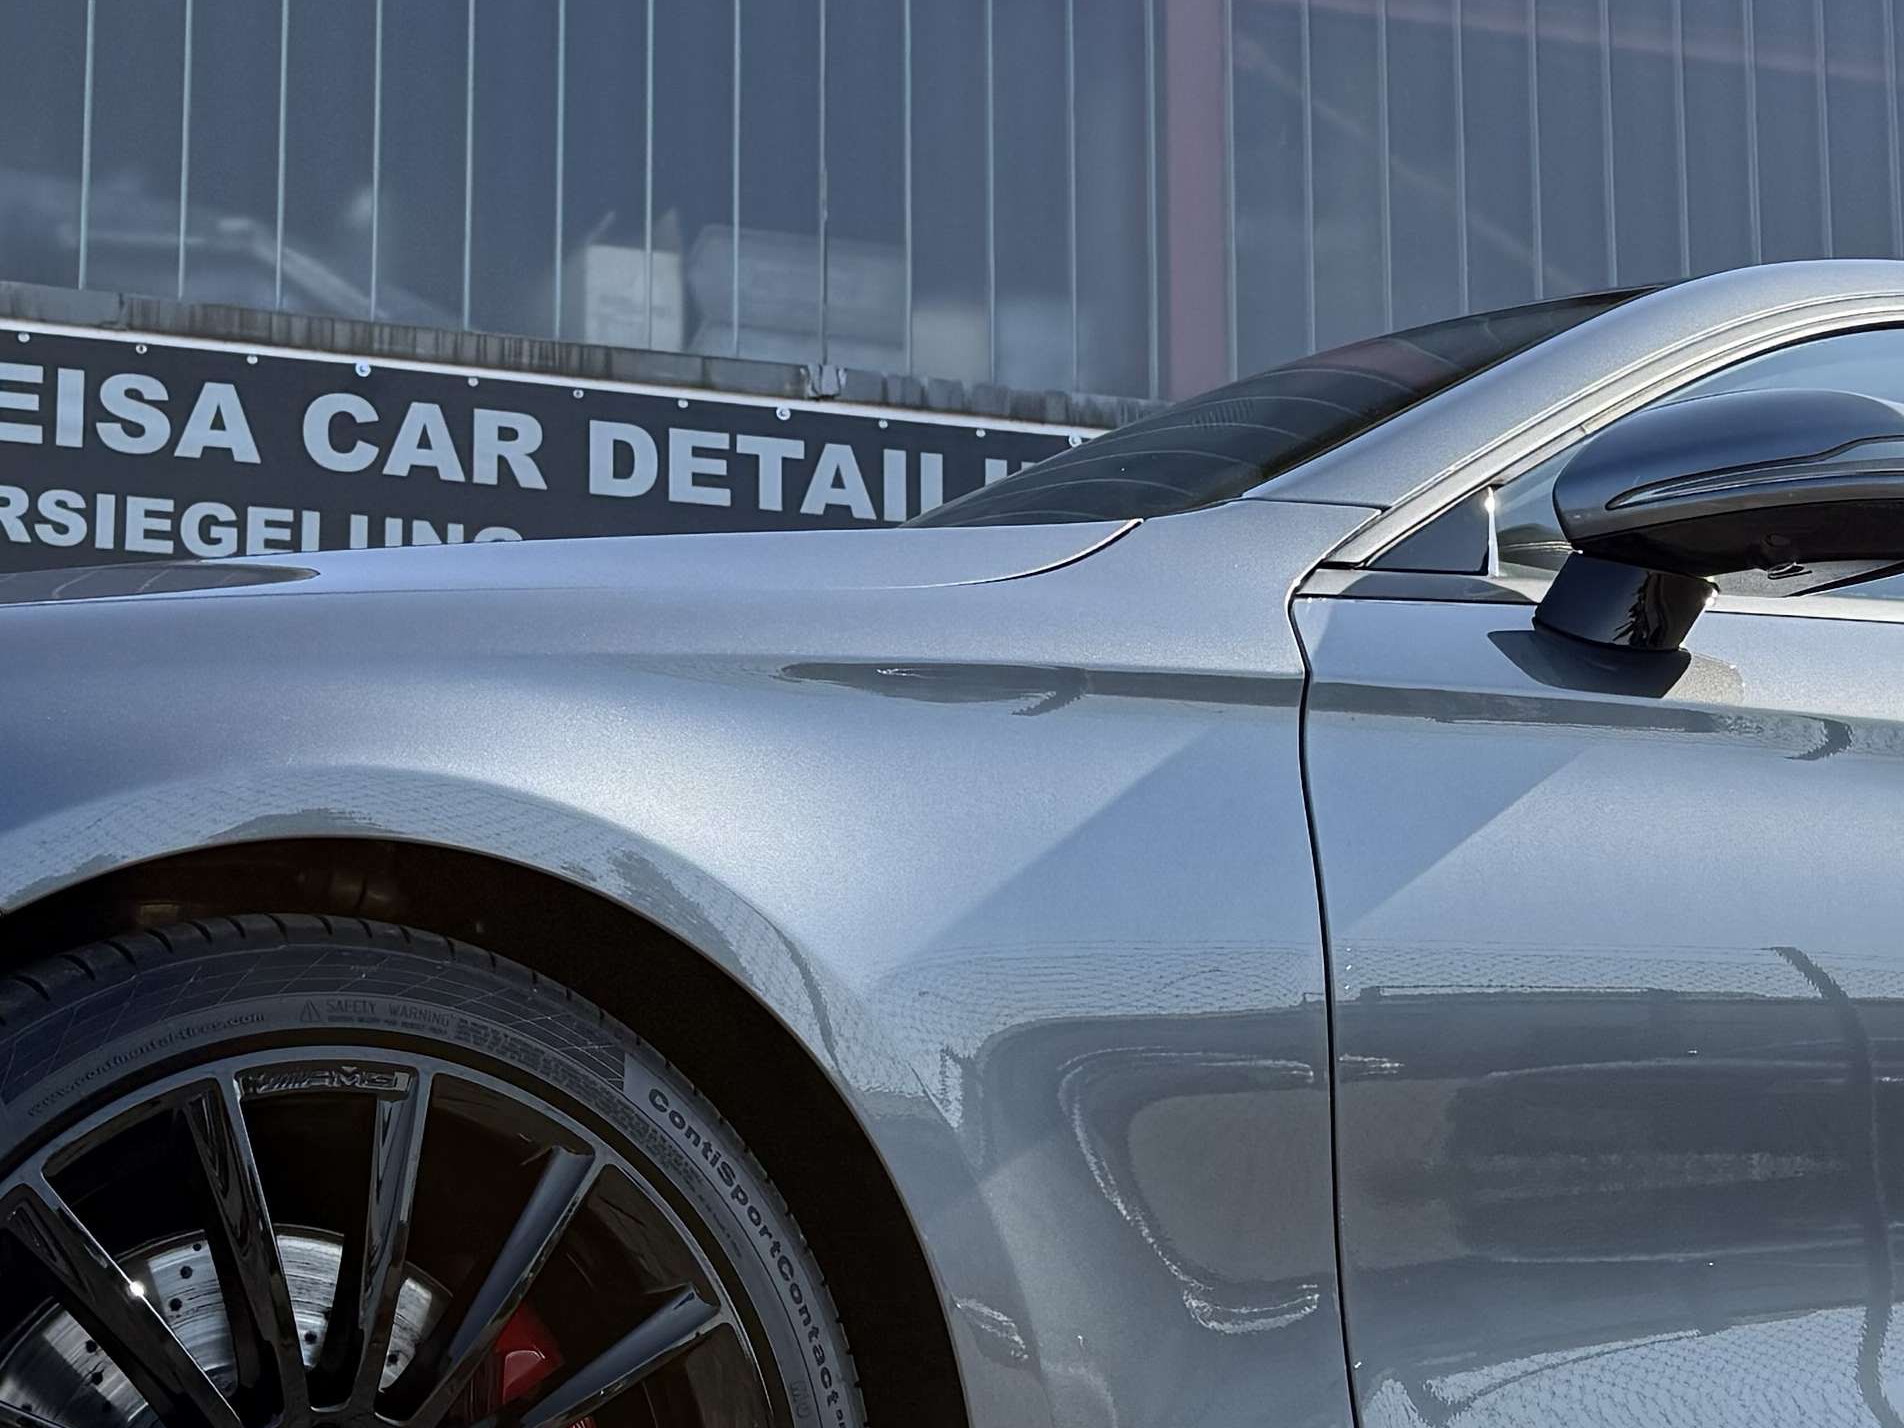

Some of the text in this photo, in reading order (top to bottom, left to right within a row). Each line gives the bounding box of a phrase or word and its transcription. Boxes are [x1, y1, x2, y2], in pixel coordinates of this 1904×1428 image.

[302, 392, 549, 492] CAR
[588, 420, 1040, 522] DETAIL
[647, 1088, 840, 1409] ContiSportContact
